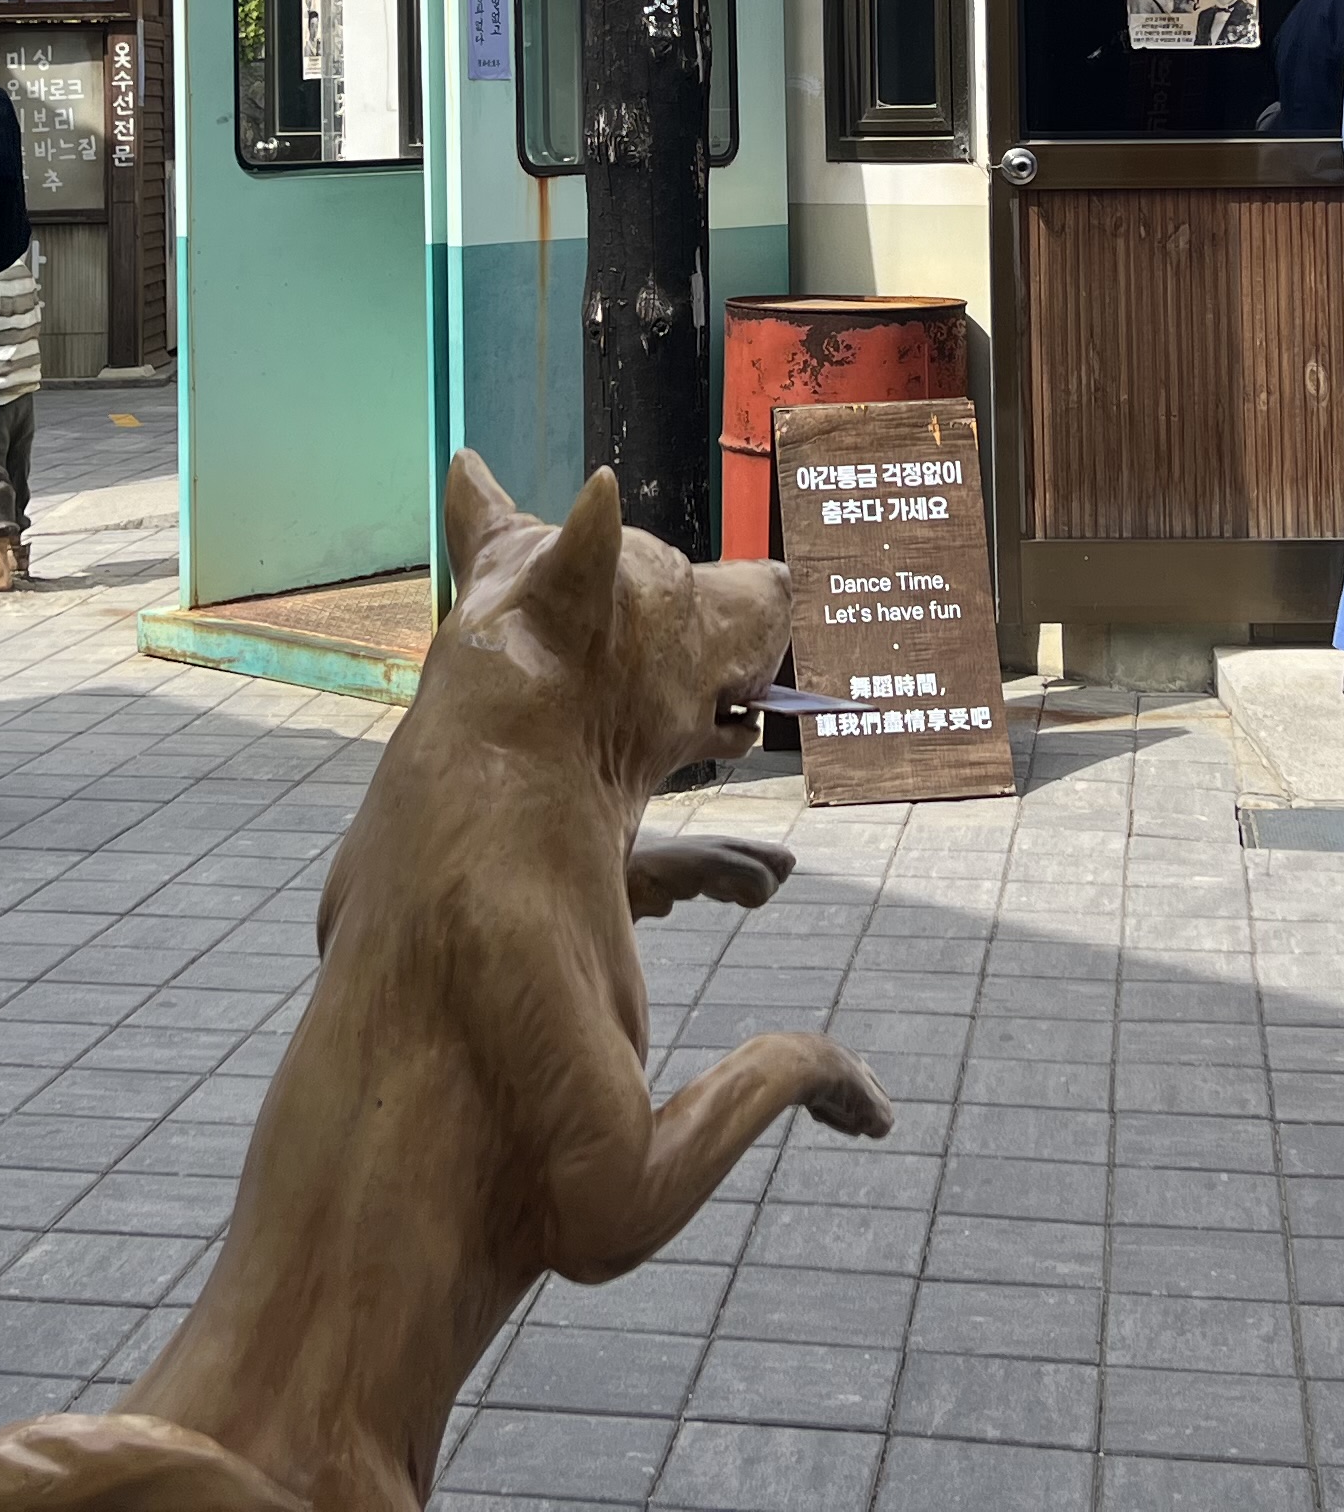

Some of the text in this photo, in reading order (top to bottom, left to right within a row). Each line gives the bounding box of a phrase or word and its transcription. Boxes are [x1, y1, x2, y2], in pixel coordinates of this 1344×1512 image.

[6, 45, 52, 71] 미싱
[7, 77, 84, 101] 오바로크
[796, 460, 962, 491] 야간통금 걱정없이
[821, 496, 950, 525] 춤추다 가세요
[830, 571, 950, 594] Dance Time,
[824, 599, 961, 624] Let's have fun
